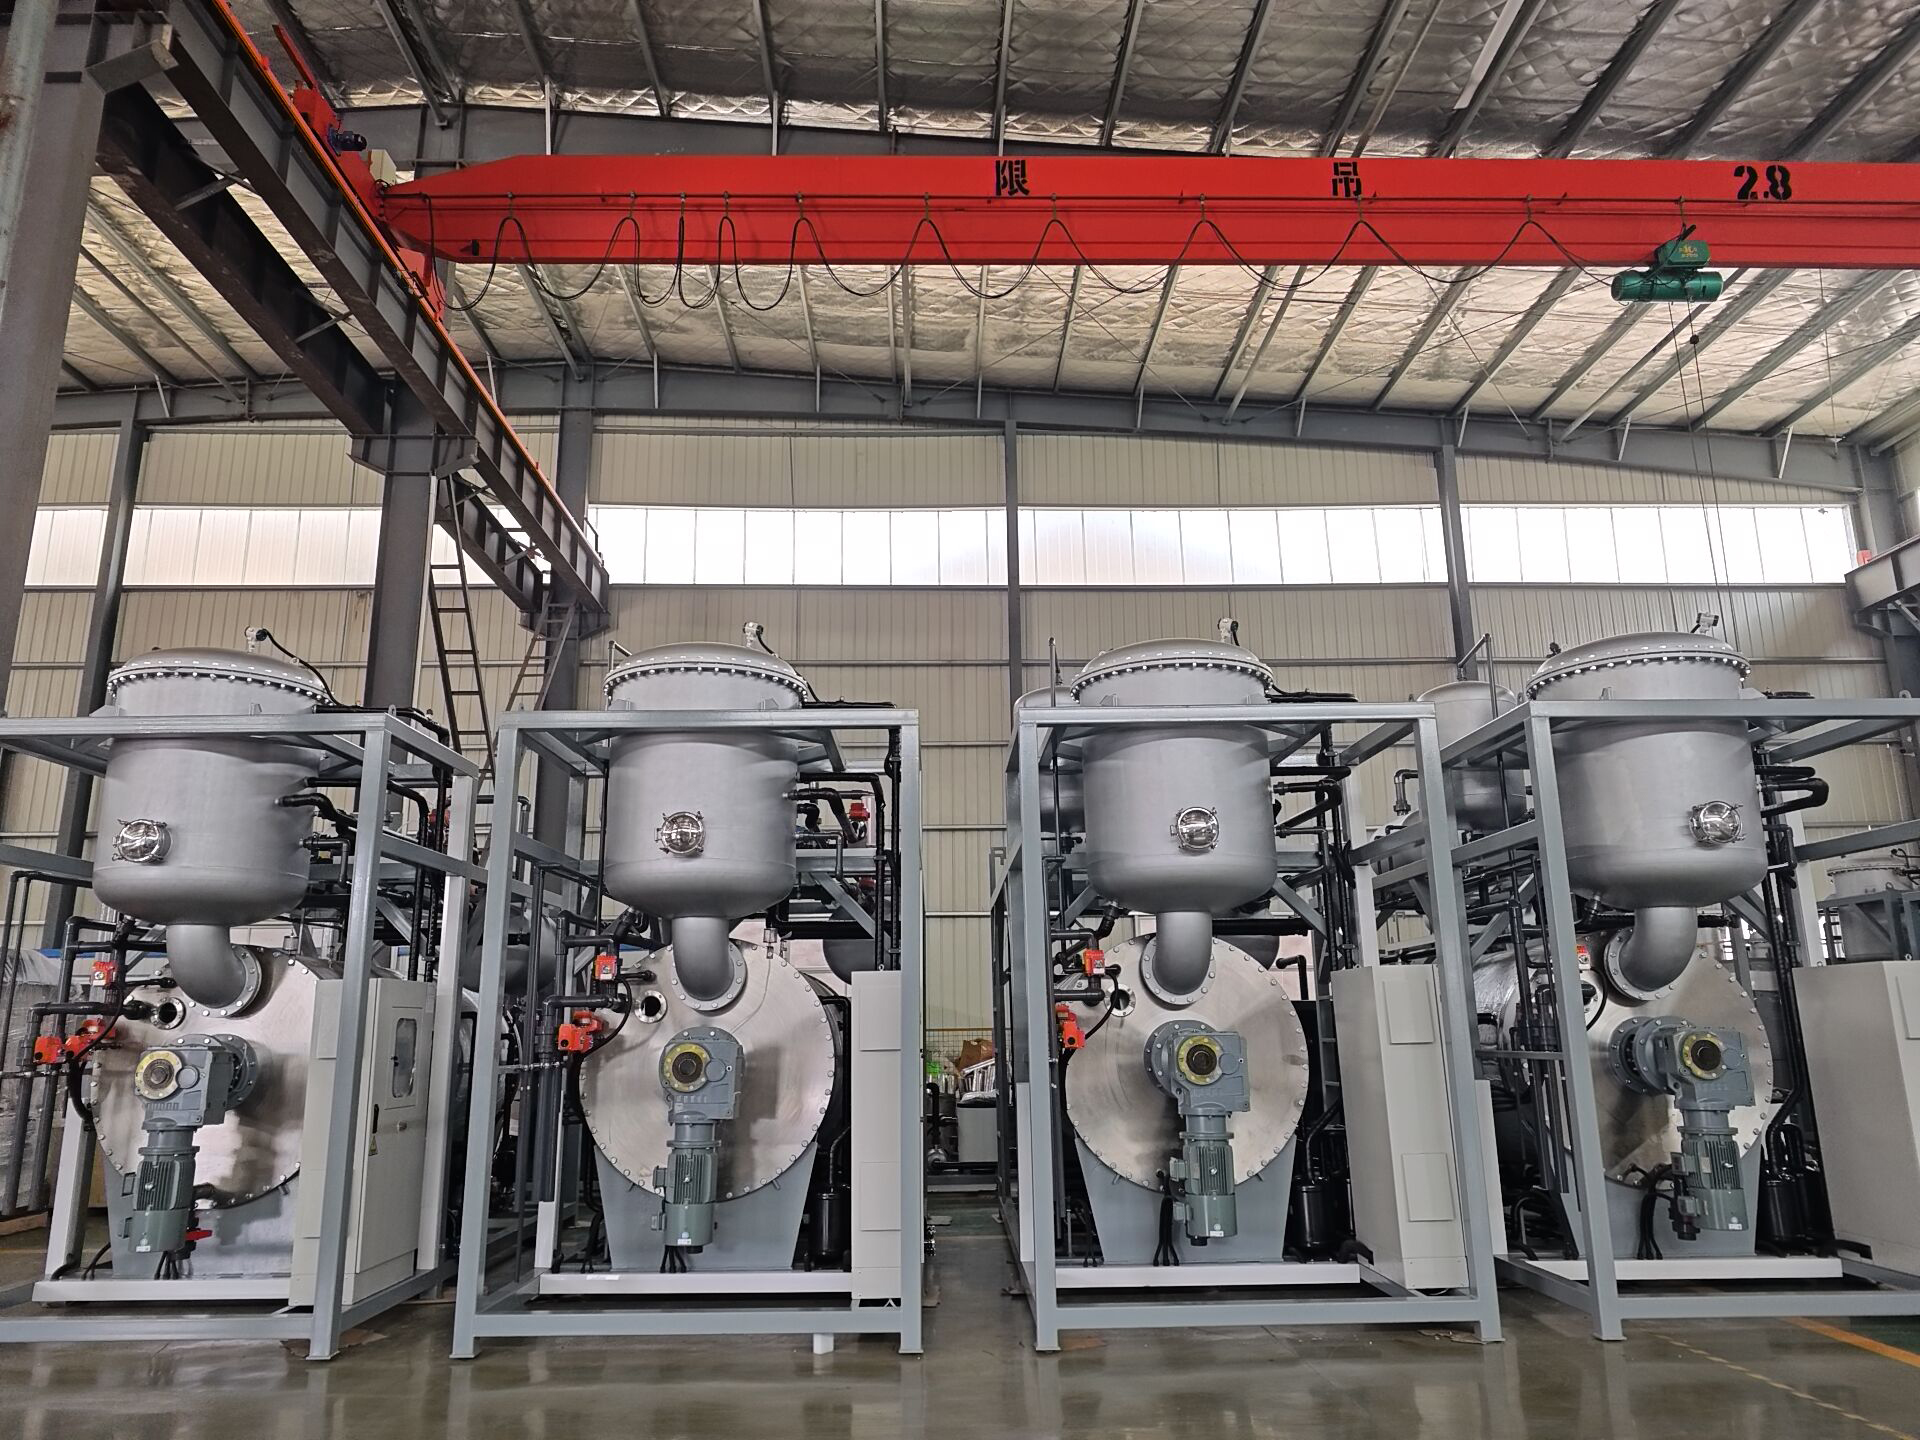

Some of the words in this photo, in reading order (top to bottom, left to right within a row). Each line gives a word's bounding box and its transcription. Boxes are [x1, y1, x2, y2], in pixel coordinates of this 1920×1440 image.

[995, 160, 1030, 196] 限
[1332, 161, 1362, 198] 吊
[1733, 165, 1792, 200] 2.8
